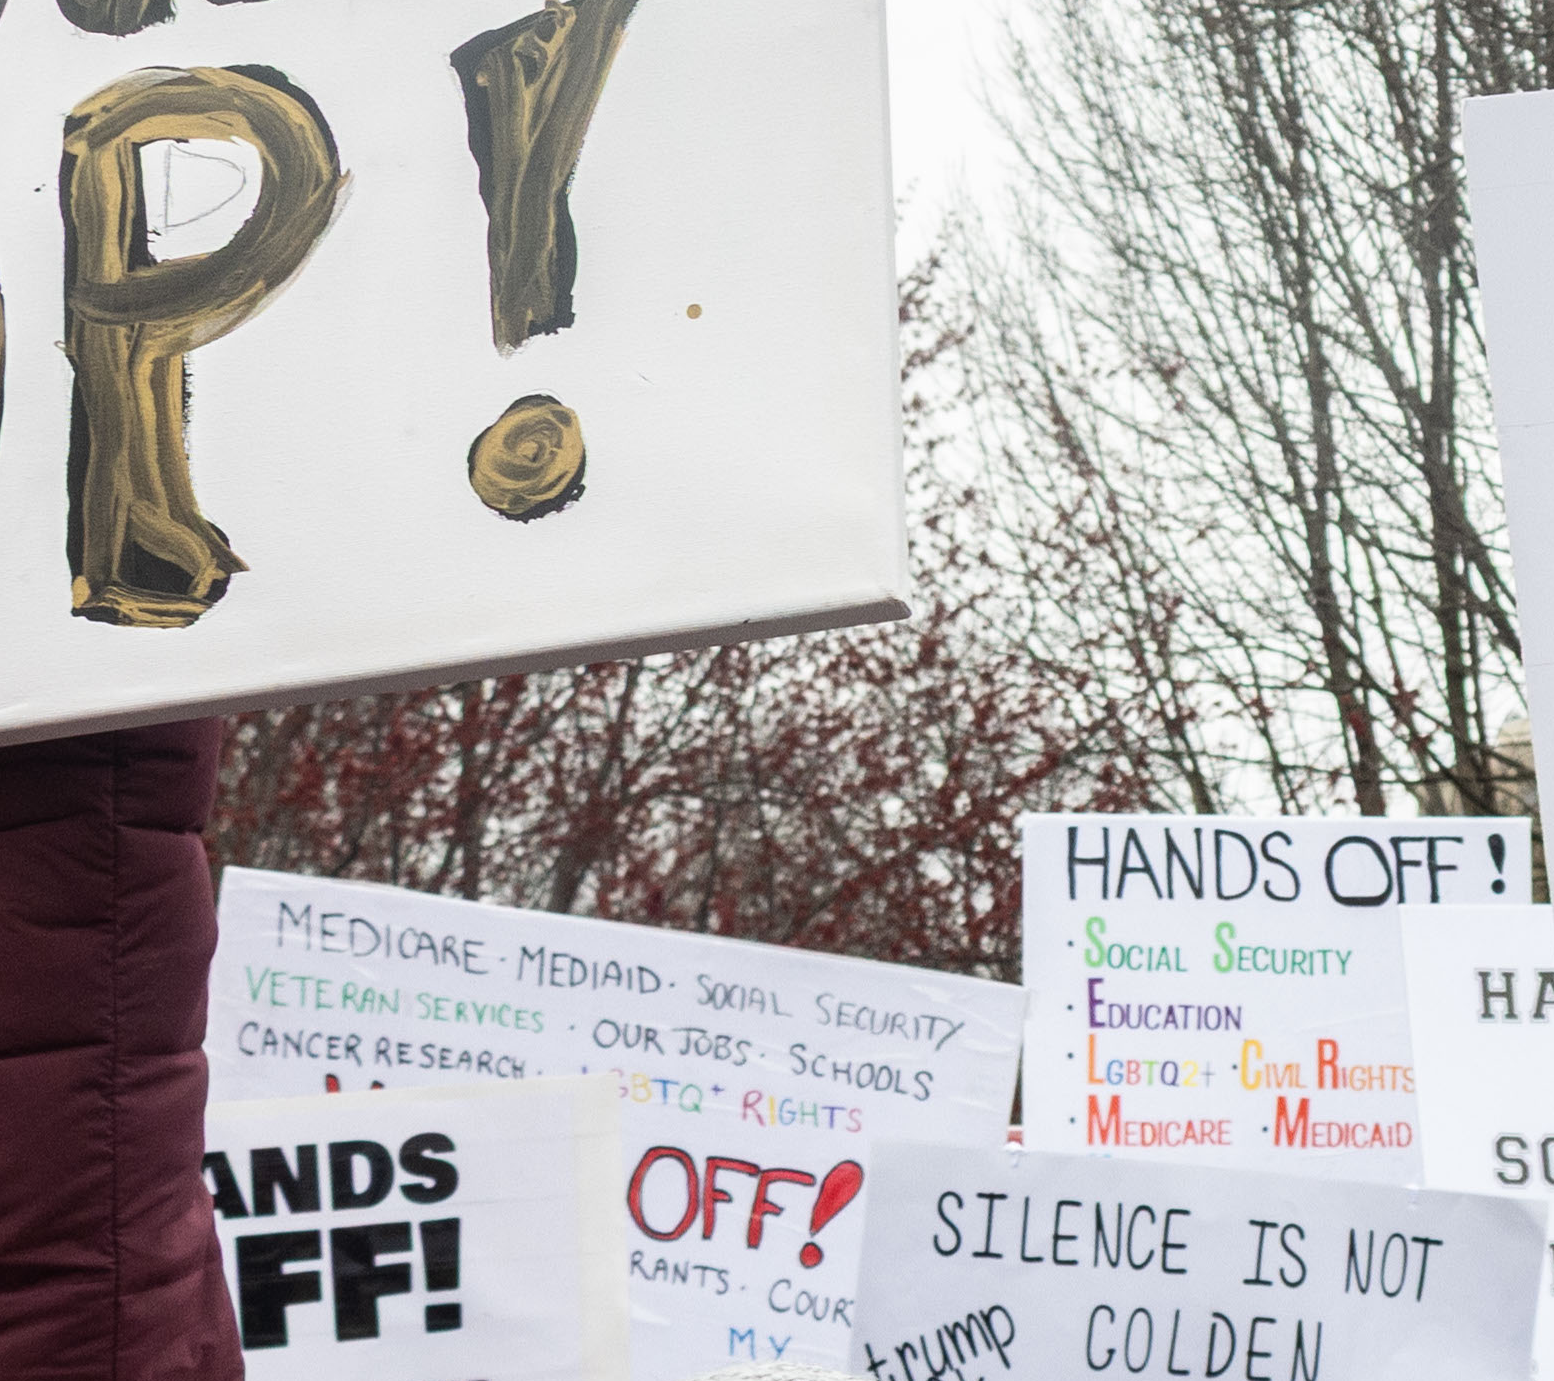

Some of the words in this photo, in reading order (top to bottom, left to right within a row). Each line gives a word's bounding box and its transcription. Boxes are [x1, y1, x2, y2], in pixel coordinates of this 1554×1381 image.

[1066, 826, 1302, 902] HANDS
[277, 901, 490, 976] MEDICARE
[815, 992, 966, 1052] SECURITY
[237, 1021, 363, 1069] CANCER
[374, 1036, 527, 1081] RESEARCH
[742, 1090, 863, 1133] RIGHTS
[244, 965, 401, 1017] VETERAN
[416, 990, 546, 1034] SERVICES
[592, 1018, 666, 1057] OUR
[671, 1026, 752, 1067] JOBS
[789, 1043, 934, 1102] SCHOOLS
[201, 1132, 460, 1220] ANDS
[627, 1145, 865, 1269] OFF!
[235, 1217, 463, 1351] FF!
[630, 1250, 730, 1296] RANTS
[768, 1278, 854, 1328] COUR
[932, 1190, 1191, 1275] SILENCE
[1243, 1218, 1307, 1288] IS
[1344, 1227, 1444, 1302] NOT
